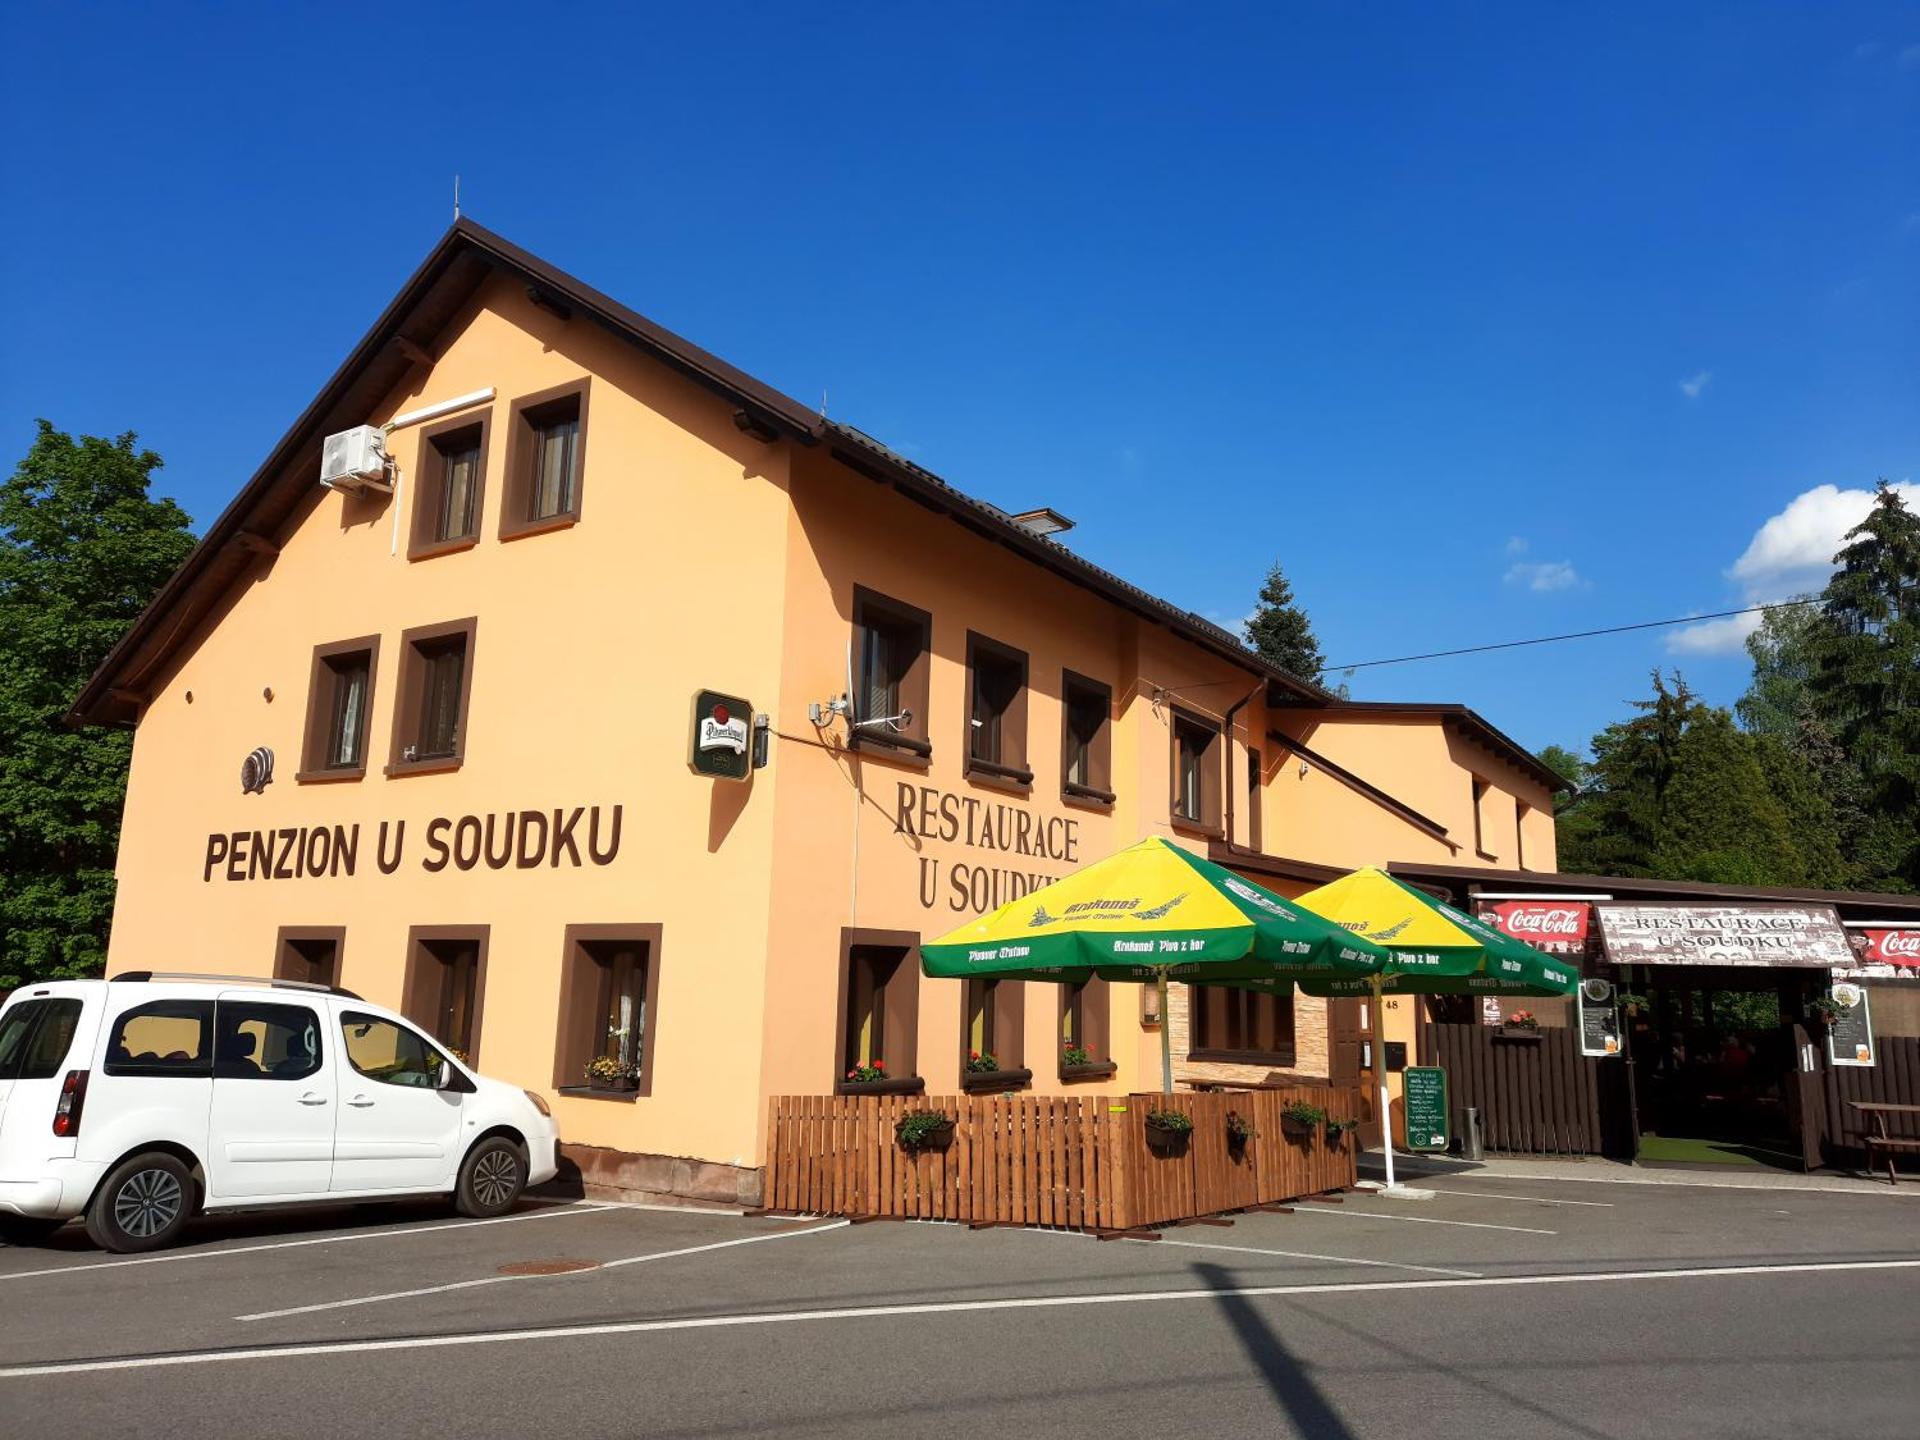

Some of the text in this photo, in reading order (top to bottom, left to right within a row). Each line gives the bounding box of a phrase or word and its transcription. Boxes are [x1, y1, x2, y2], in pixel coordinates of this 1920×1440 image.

[894, 782, 1079, 863] RESTAURACE
[203, 804, 623, 883] PENZION U SOUDKU
[919, 857, 1062, 914] U SOUD
[1508, 909, 1580, 934] Coca-Cola
[1635, 918, 1805, 930] RESTAURACE
[1657, 936, 1793, 948] U SOUDKU
[1385, 1001, 1399, 1010] 48
